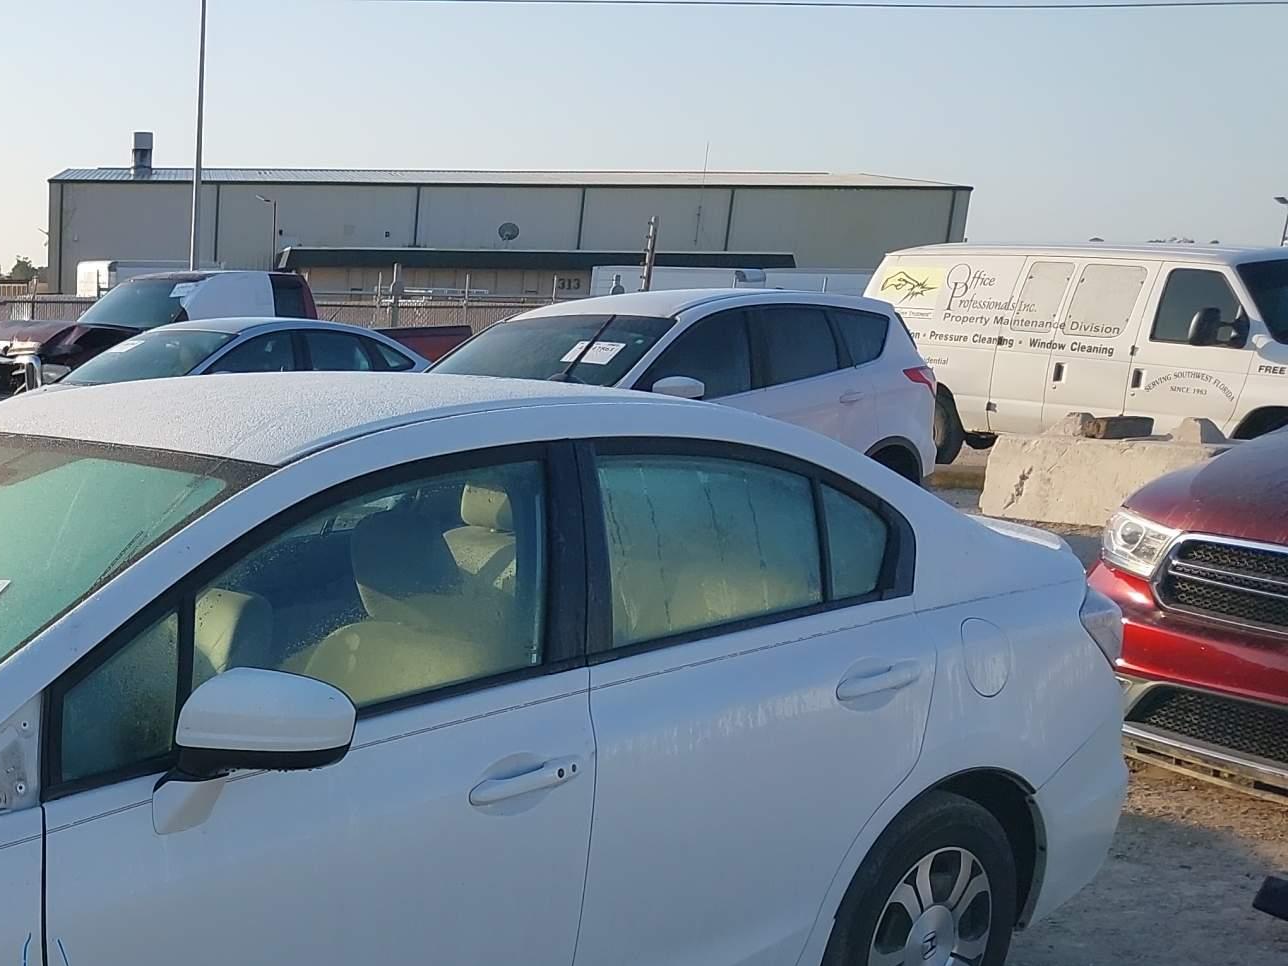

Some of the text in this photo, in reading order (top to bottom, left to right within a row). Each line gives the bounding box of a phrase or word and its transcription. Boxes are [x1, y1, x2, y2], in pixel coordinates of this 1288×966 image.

[558, 278, 580, 290] 313
[946, 263, 996, 290] Office
[943, 281, 1037, 313] Professionals Inc.
[942, 312, 1120, 336] Property Maintenance Division
[929, 330, 969, 343] Pressure
[972, 333, 1014, 348] Cleanng
[1029, 338, 1067, 351] Window
[1070, 342, 1115, 357] Cleaning
[1258, 365, 1286, 375] FREE
[1144, 371, 1235, 402] SERVING SOUTHWEST FLORIDA
[1170, 385, 1190, 394] SINCE
